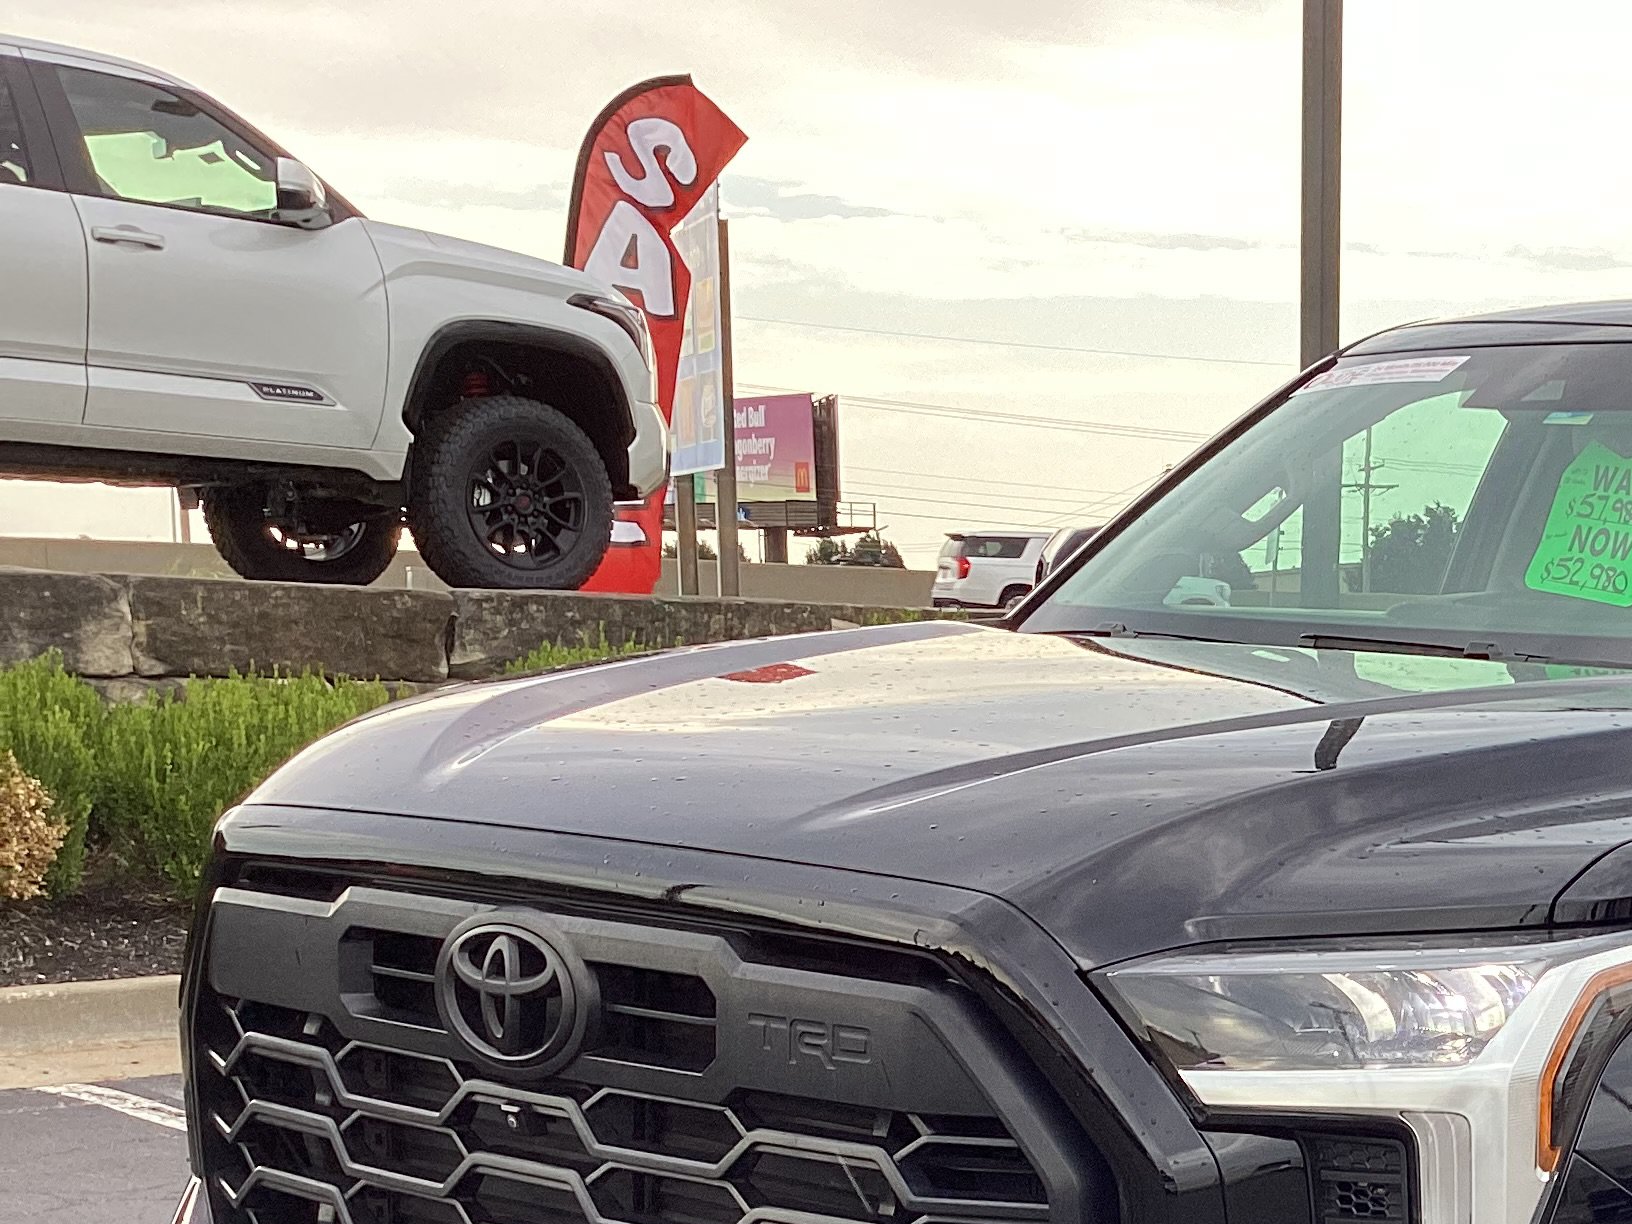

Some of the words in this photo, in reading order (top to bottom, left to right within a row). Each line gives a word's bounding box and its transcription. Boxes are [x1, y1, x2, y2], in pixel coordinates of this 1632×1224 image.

[262, 386, 314, 397] PLATINUM
[748, 405, 766, 428] Bull
[735, 433, 775, 461] gonberry
[1540, 556, 1628, 593] $52,980
[748, 1012, 872, 1071] TRD
